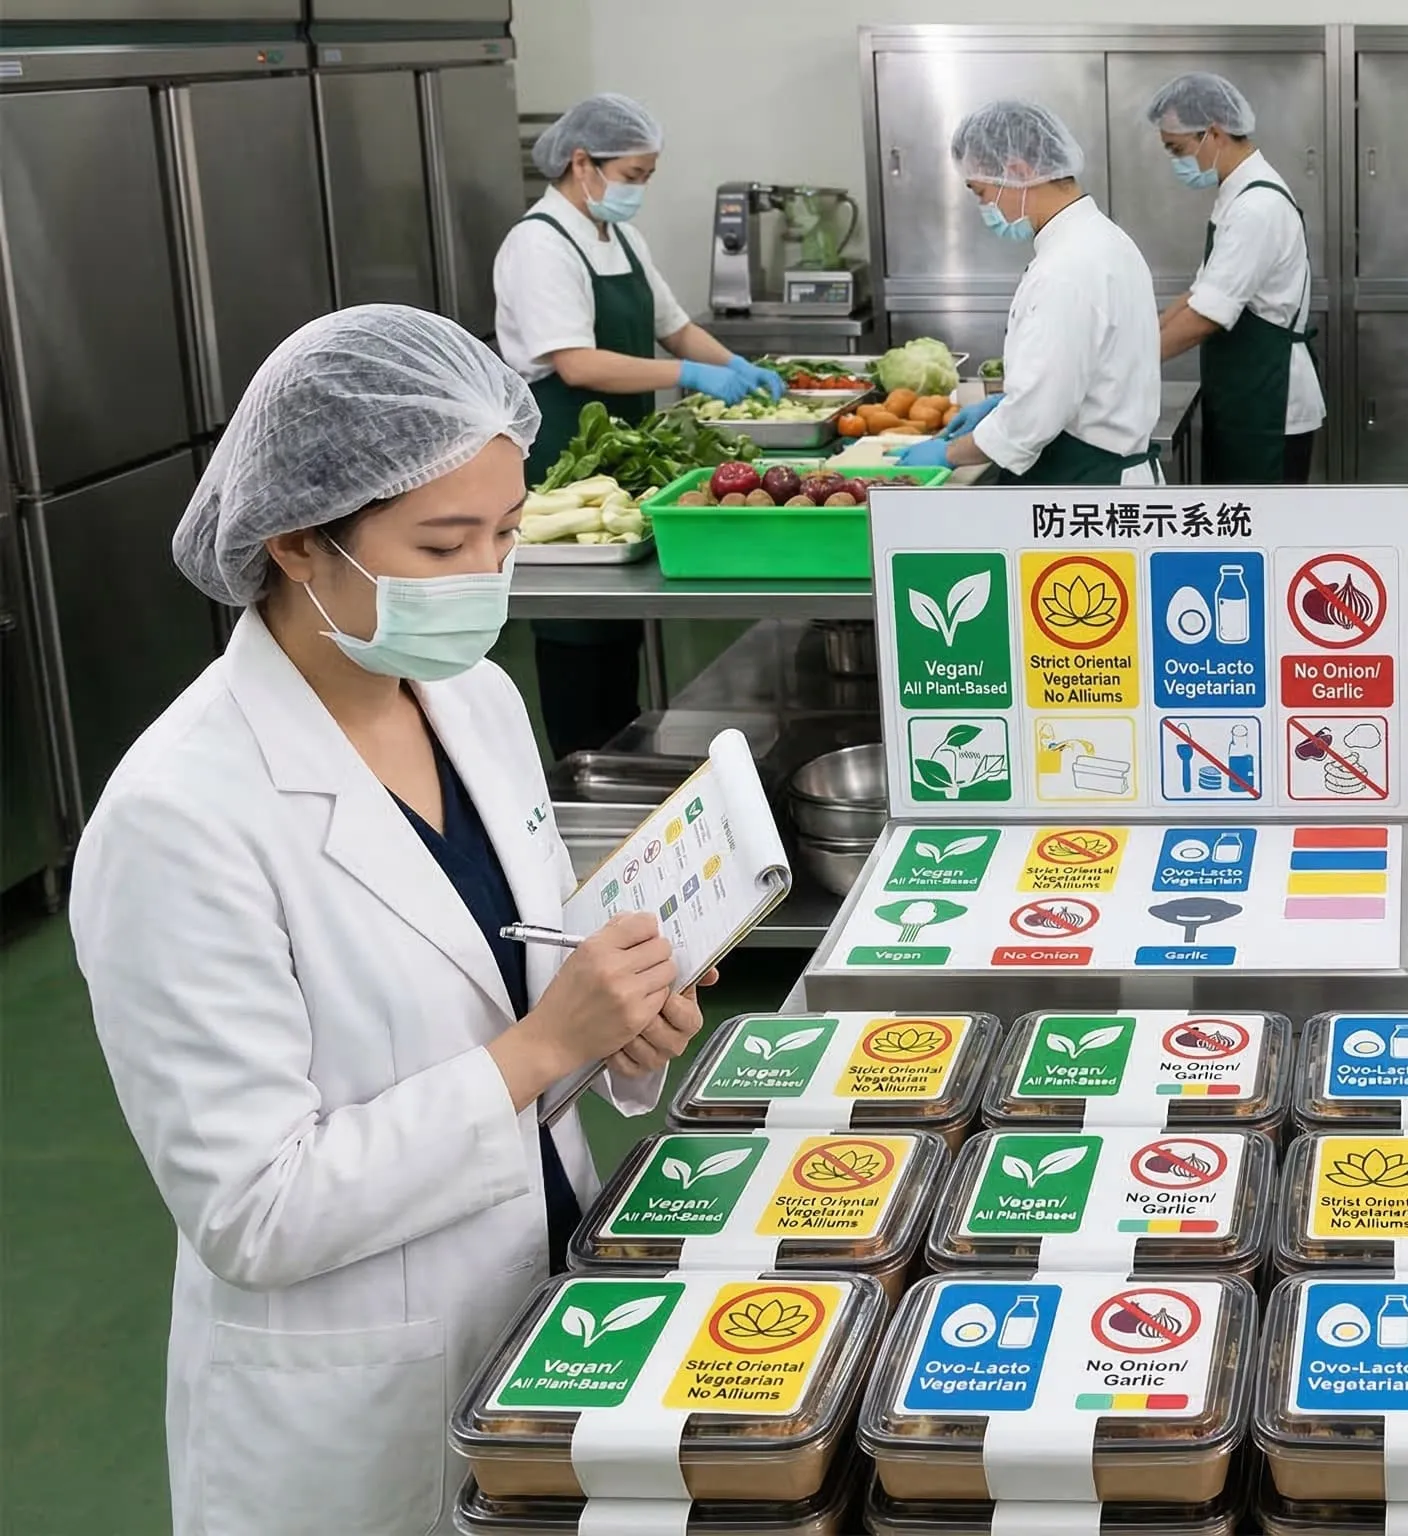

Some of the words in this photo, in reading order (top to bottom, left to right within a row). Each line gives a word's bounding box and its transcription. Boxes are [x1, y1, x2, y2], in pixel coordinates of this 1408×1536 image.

[1032, 502, 1253, 539] 防呆標示系統
[1030, 655, 1069, 668] Strict
[1074, 656, 1131, 669] Oriental
[1165, 659, 1254, 675] Ovo-Lacto
[925, 660, 983, 679] Vegan/
[1295, 663, 1318, 678] No
[1323, 663, 1381, 679] Onion/
[1044, 672, 1120, 687] Vegetarian
[904, 682, 921, 694] All
[927, 682, 1007, 695] Plant-Based
[1164, 679, 1256, 698] Vegetarian
[1312, 683, 1364, 699] Garlic
[1045, 690, 1064, 702] No
[1068, 689, 1122, 702] Alliums
[912, 868, 963, 878] Vegan
[1162, 868, 1243, 876] Ovo-Lacto
[876, 952, 921, 960] Vegan
[1003, 952, 1027, 960] No
[1030, 952, 1079, 960] Onion
[1164, 952, 1209, 960] Garlic
[1044, 1064, 1108, 1077] Vegan/
[1160, 1062, 1182, 1071] No
[1187, 1062, 1240, 1072] Onion/
[1024, 1078, 1042, 1086] All
[1174, 1071, 1223, 1080] Garlic
[851, 1084, 873, 1092] No
[648, 1197, 719, 1211] Vegan/
[775, 1196, 816, 1206] Strict
[998, 1196, 1068, 1210] Vegan/
[1126, 1192, 1151, 1203] No
[1156, 1192, 1217, 1204] Onion/
[975, 1210, 994, 1220] All
[1142, 1203, 1197, 1215] Garlic
[618, 1213, 640, 1222] All
[778, 1218, 799, 1227] No
[801, 1217, 858, 1228] Alliums
[1330, 1218, 1351, 1228] No
[543, 1359, 623, 1376] Vegan/
[686, 1359, 733, 1372] Strict
[736, 1359, 804, 1373] Oriental
[925, 1360, 1031, 1374] Ovo-Lacto
[1086, 1359, 1112, 1372] No
[1119, 1359, 1189, 1372] Onion/
[510, 1378, 533, 1389] All
[919, 1377, 1027, 1393] Vegetarian
[1104, 1373, 1165, 1387] Garlic
[688, 1388, 711, 1399] No
[714, 1388, 781, 1401] Alliums
